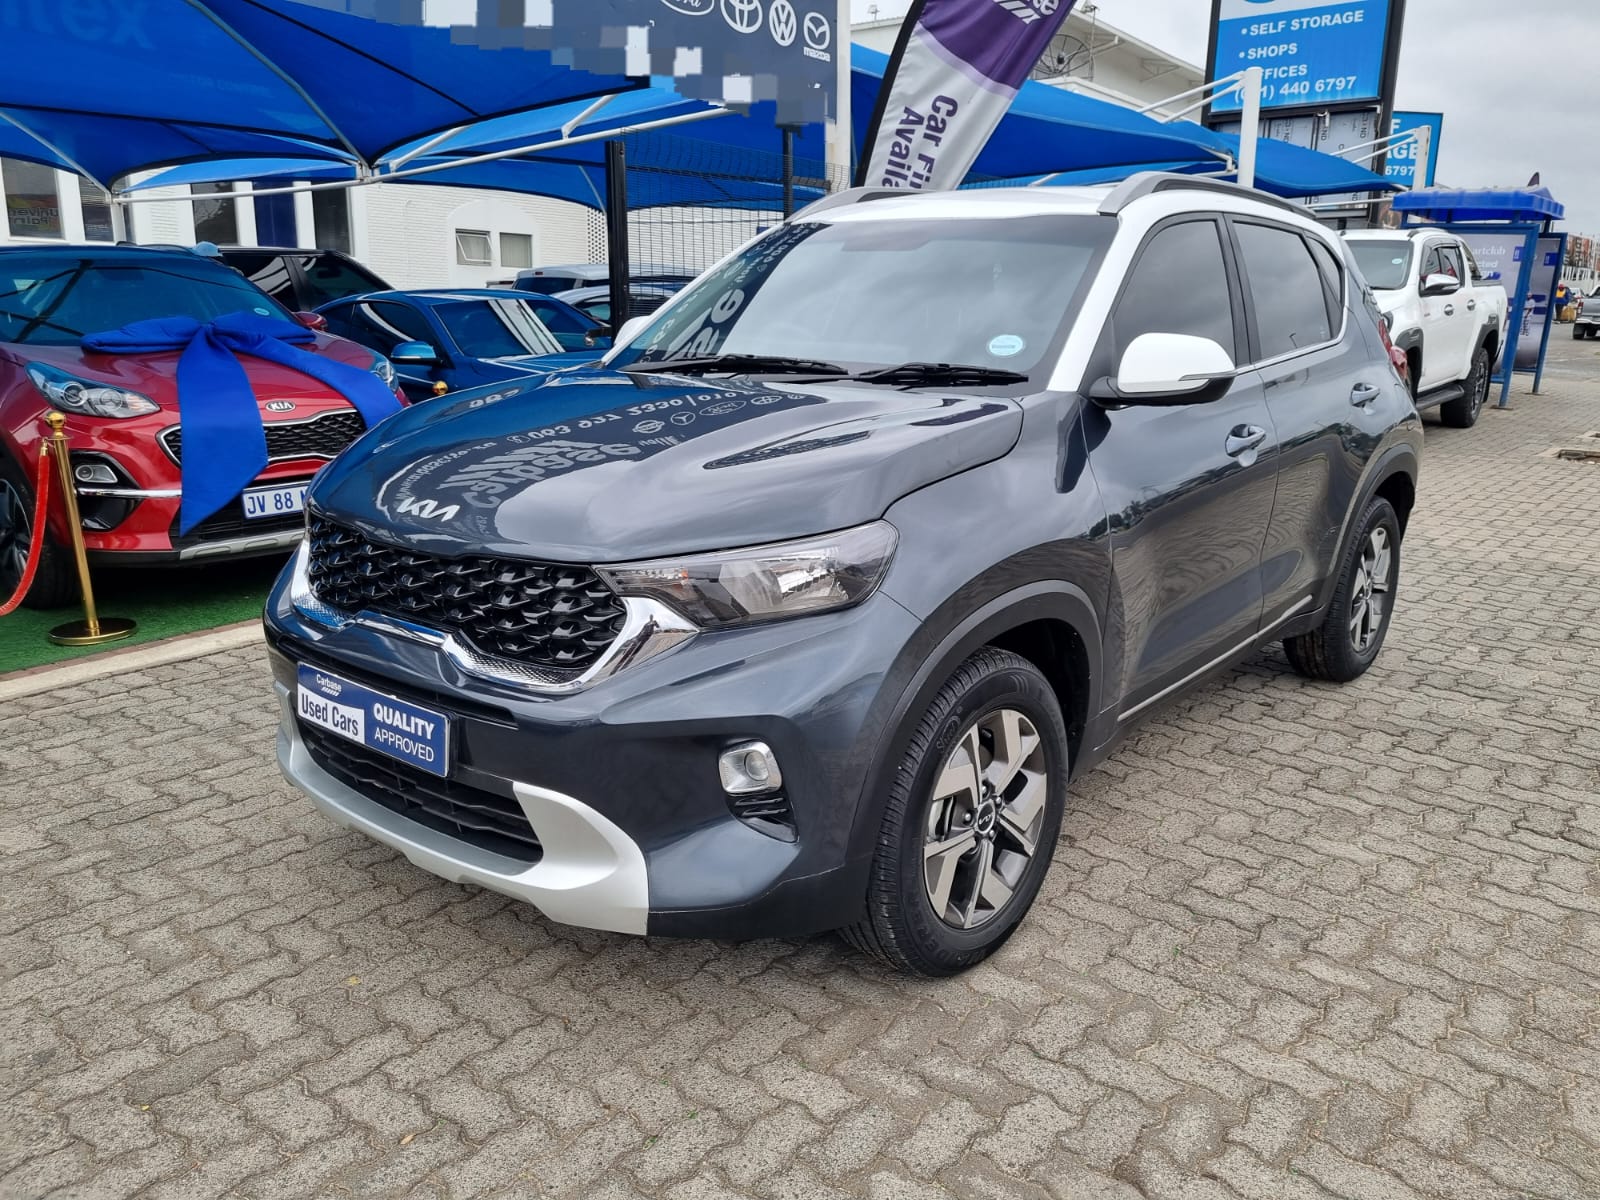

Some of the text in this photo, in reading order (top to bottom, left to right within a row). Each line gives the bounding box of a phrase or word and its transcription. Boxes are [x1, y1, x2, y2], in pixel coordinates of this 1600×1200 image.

[1249, 10, 1364, 36] SELF STORAGE
[1247, 43, 1298, 60] SHOPS
[1279, 79, 1311, 96] 440
[1314, 76, 1357, 93] 6797
[923, 95, 958, 147] Car
[1385, 165, 1415, 176] 6797
[270, 401, 293, 410] KIA
[247, 495, 266, 515] JV
[273, 491, 294, 511] 88
[316, 674, 342, 693] Carbase
[302, 693, 359, 736] Used Cars
[373, 703, 435, 740] QUALITY
[374, 727, 435, 762] APPROVED
